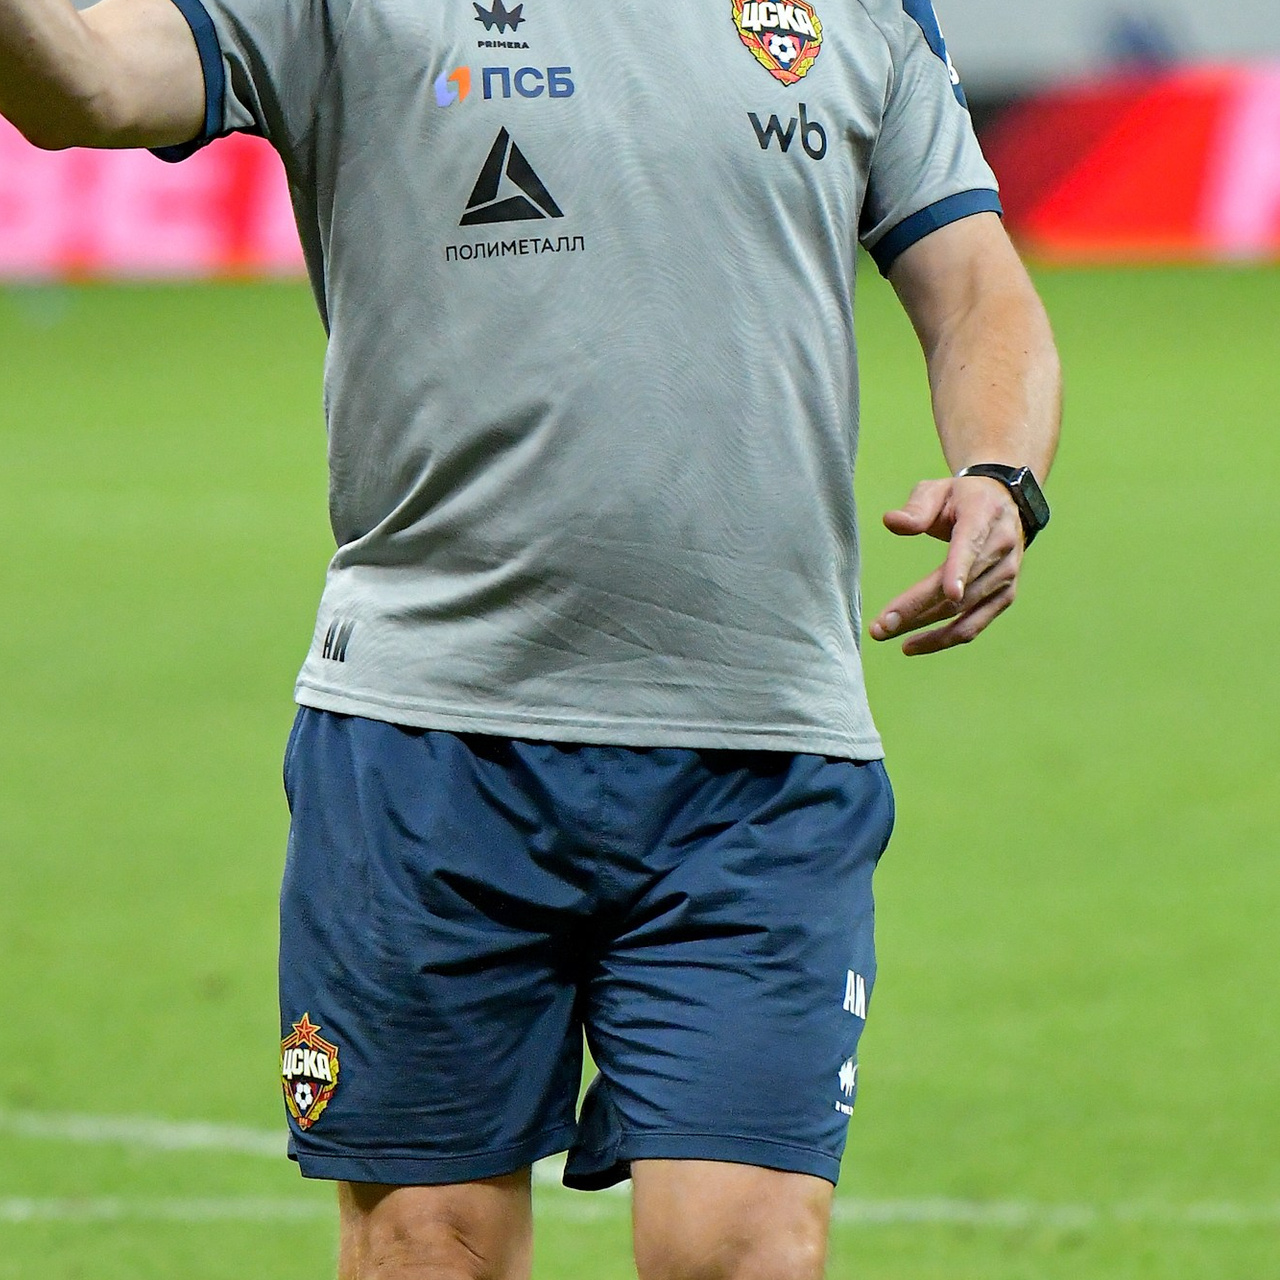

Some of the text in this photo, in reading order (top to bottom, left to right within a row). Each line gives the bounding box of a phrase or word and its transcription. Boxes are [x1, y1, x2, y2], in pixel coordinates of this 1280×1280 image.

[740, 1, 818, 40] ЦСКА
[477, 39, 530, 50] PRIMERA
[481, 66, 576, 100] ПСБ
[746, 102, 828, 162] wb
[445, 235, 586, 262] ПОЛИМЕТАЛЛ
[282, 1047, 333, 1082] ЦСКА
